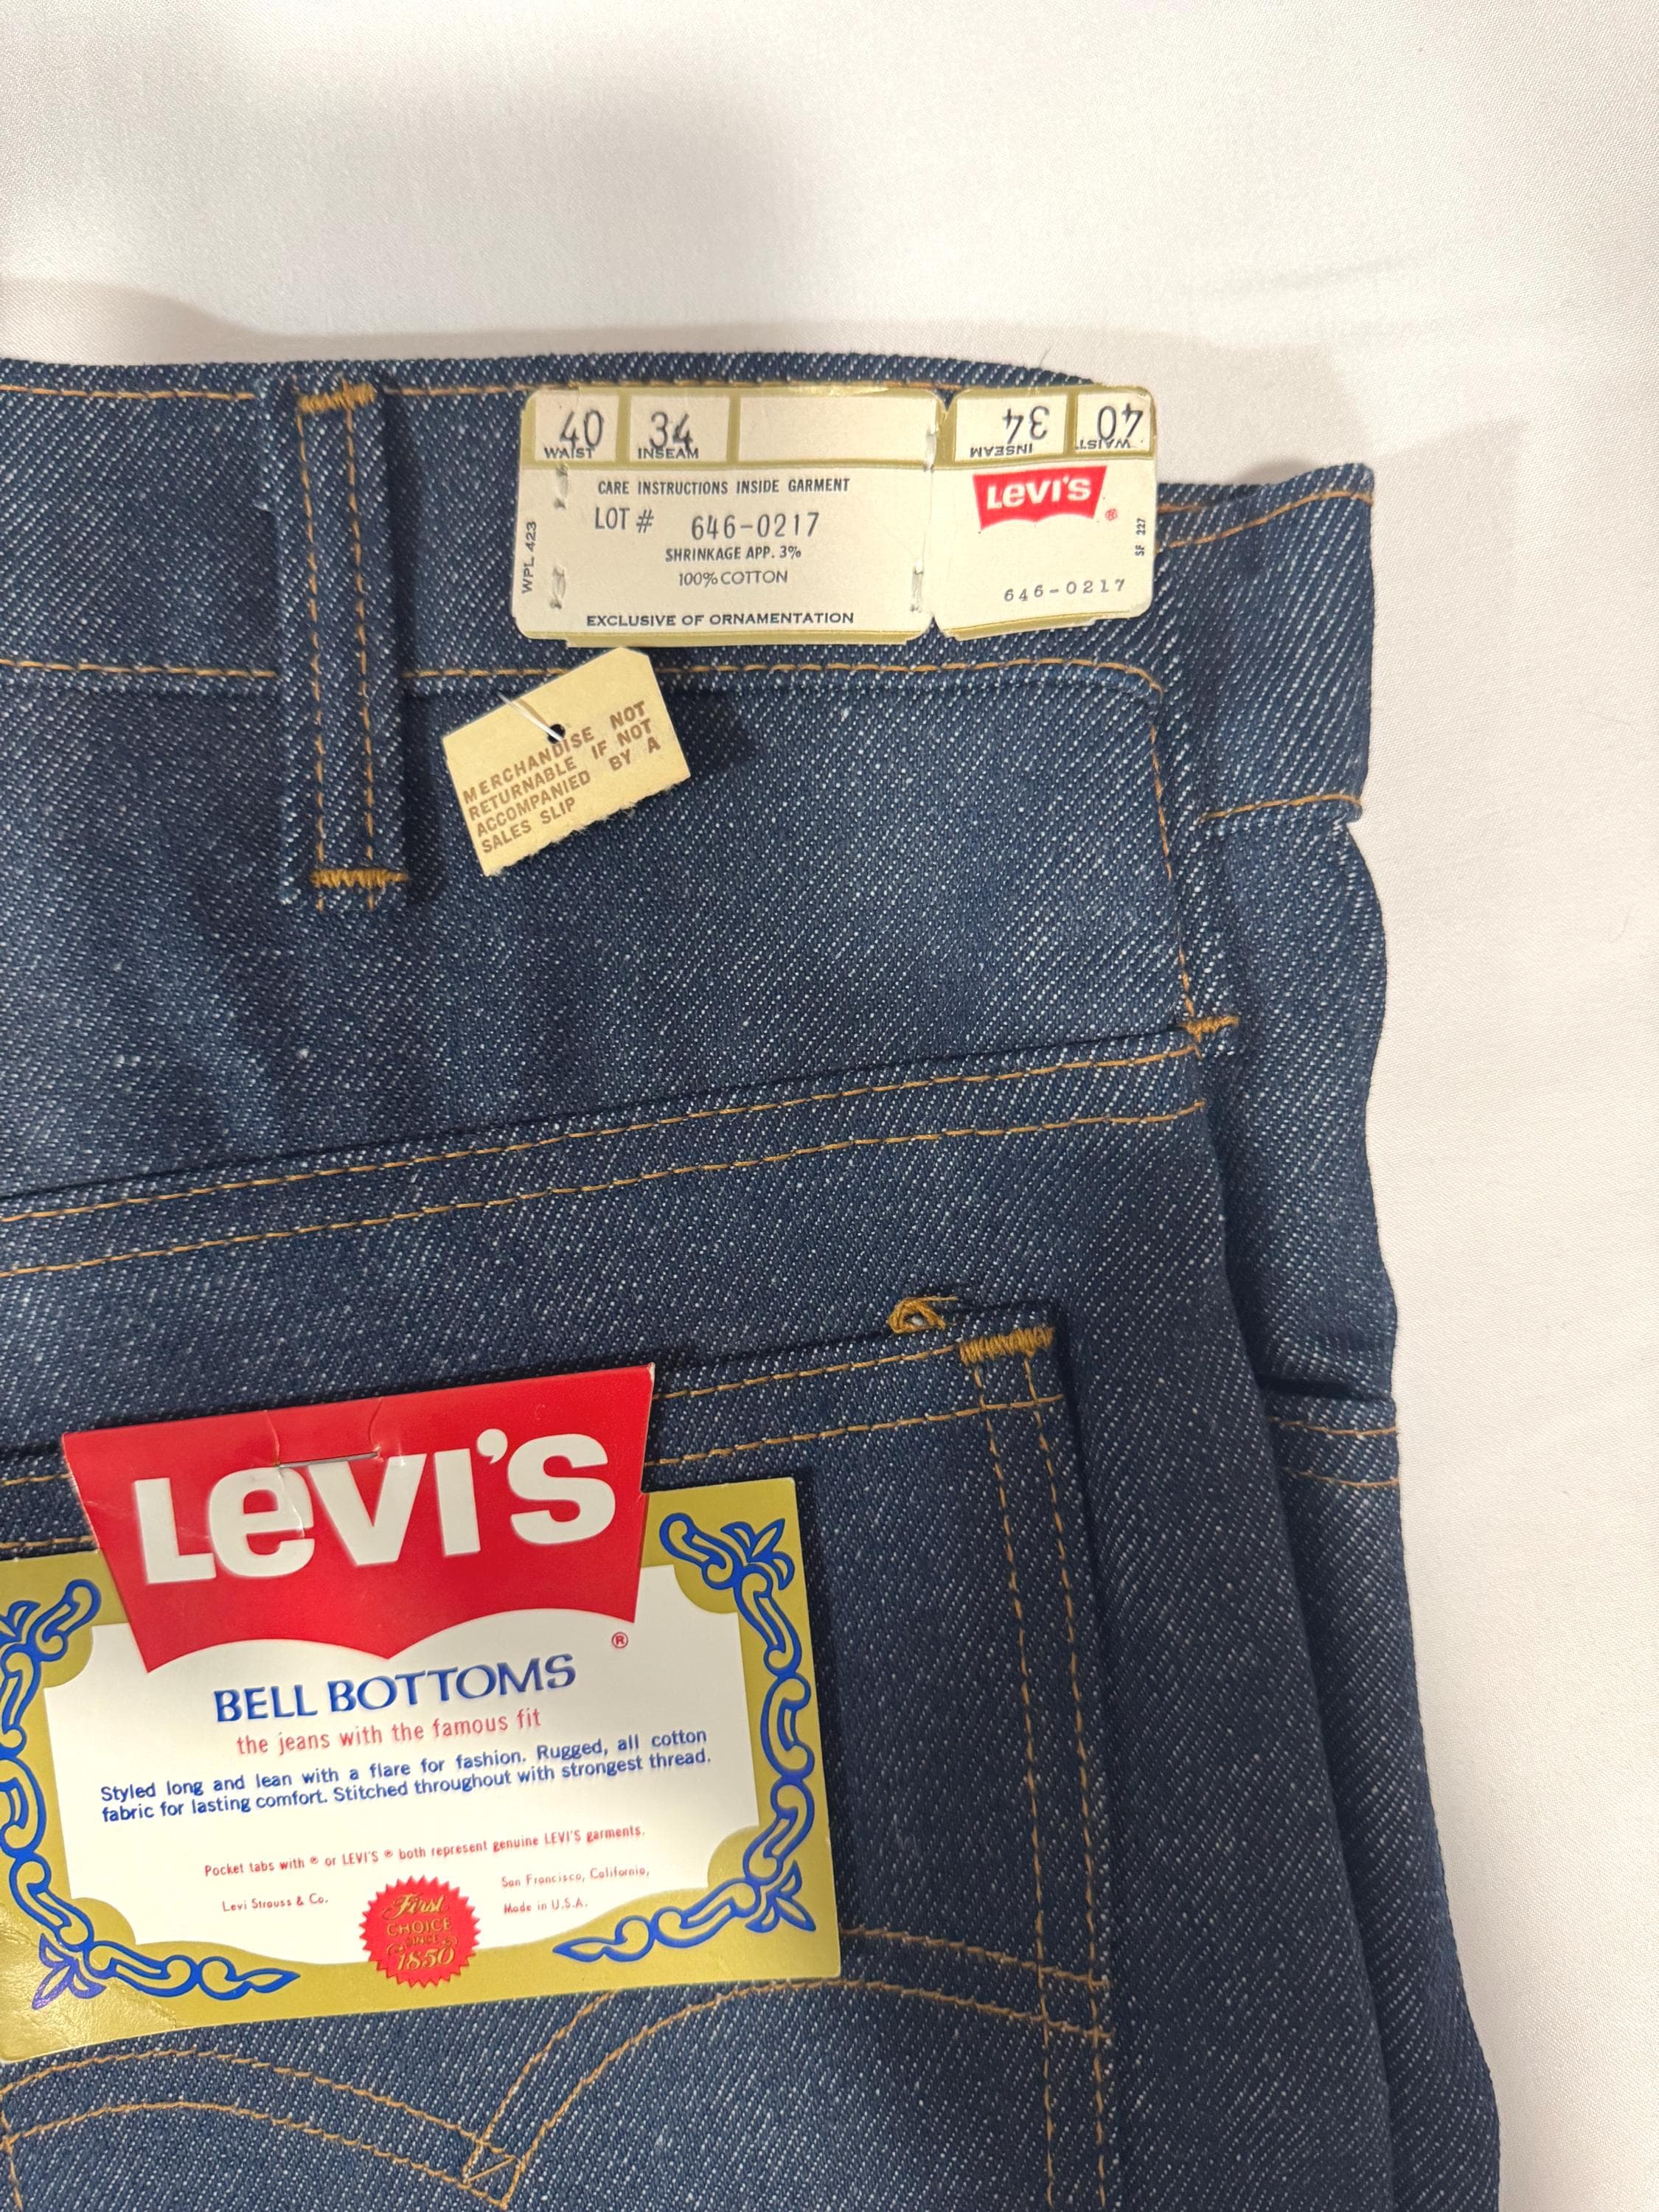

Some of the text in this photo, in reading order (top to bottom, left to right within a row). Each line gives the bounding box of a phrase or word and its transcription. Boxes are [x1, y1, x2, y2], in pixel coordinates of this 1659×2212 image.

[560, 410, 605, 451] 40
[649, 411, 693, 452] 34
[1002, 405, 1050, 444] 34
[1096, 403, 1144, 441] 40
[544, 447, 595, 459] WAIST
[638, 448, 699, 459] INSEAM
[970, 442, 1032, 458] INSEAM
[1076, 438, 1131, 451] WAIST
[598, 477, 851, 495] CARE INSTRUCTIONS INSIDE GARMENT
[594, 507, 654, 534] LOT #
[691, 511, 820, 540] 646-0217
[1136, 518, 1146, 535] 227
[521, 521, 538, 593] WPL 423
[665, 545, 802, 563] SHRINKAGE APP. 3%
[1004, 578, 1125, 602] 646-0217
[586, 611, 855, 627] EXCLUSIVE OF ORNAMENTATION
[463, 700, 645, 804] MERCHANDISE NOT
[469, 718, 652, 821] RETURNABLE IF NOT
[478, 737, 661, 837] ACCOMPANIED BY A
[481, 796, 577, 854] SALES SLIP
[214, 1653, 577, 1722] BELL BOTTOMS
[236, 1708, 542, 1756] the jeans with the famous fit
[100, 1728, 707, 1803] Styled long and lean with a flare for fashion. Rugged, all cotton
[102, 1748, 712, 1823] fabric for lasting comfort. Stitched throughout with strongest thread.
[204, 1863, 244, 1877] Pocket
[249, 1860, 274, 1874] tabs
[279, 1857, 305, 1871] with
[324, 1857, 336, 1867] or
[342, 1850, 379, 1865] LEVI'S
[399, 1846, 426, 1860] both
[431, 1840, 487, 1858] represent
[493, 1835, 539, 1852] genuine
[544, 1829, 582, 1845] LEVI'S
[586, 1824, 646, 1843] garments.
[501, 1865, 650, 1888] San Francisco, California,
[222, 1893, 329, 1912] Levi Strauss & Co.
[504, 1896, 588, 1914] Made in U.S.A.
[386, 1916, 452, 1936] CHOICE
[397, 1947, 456, 1971] 1850
